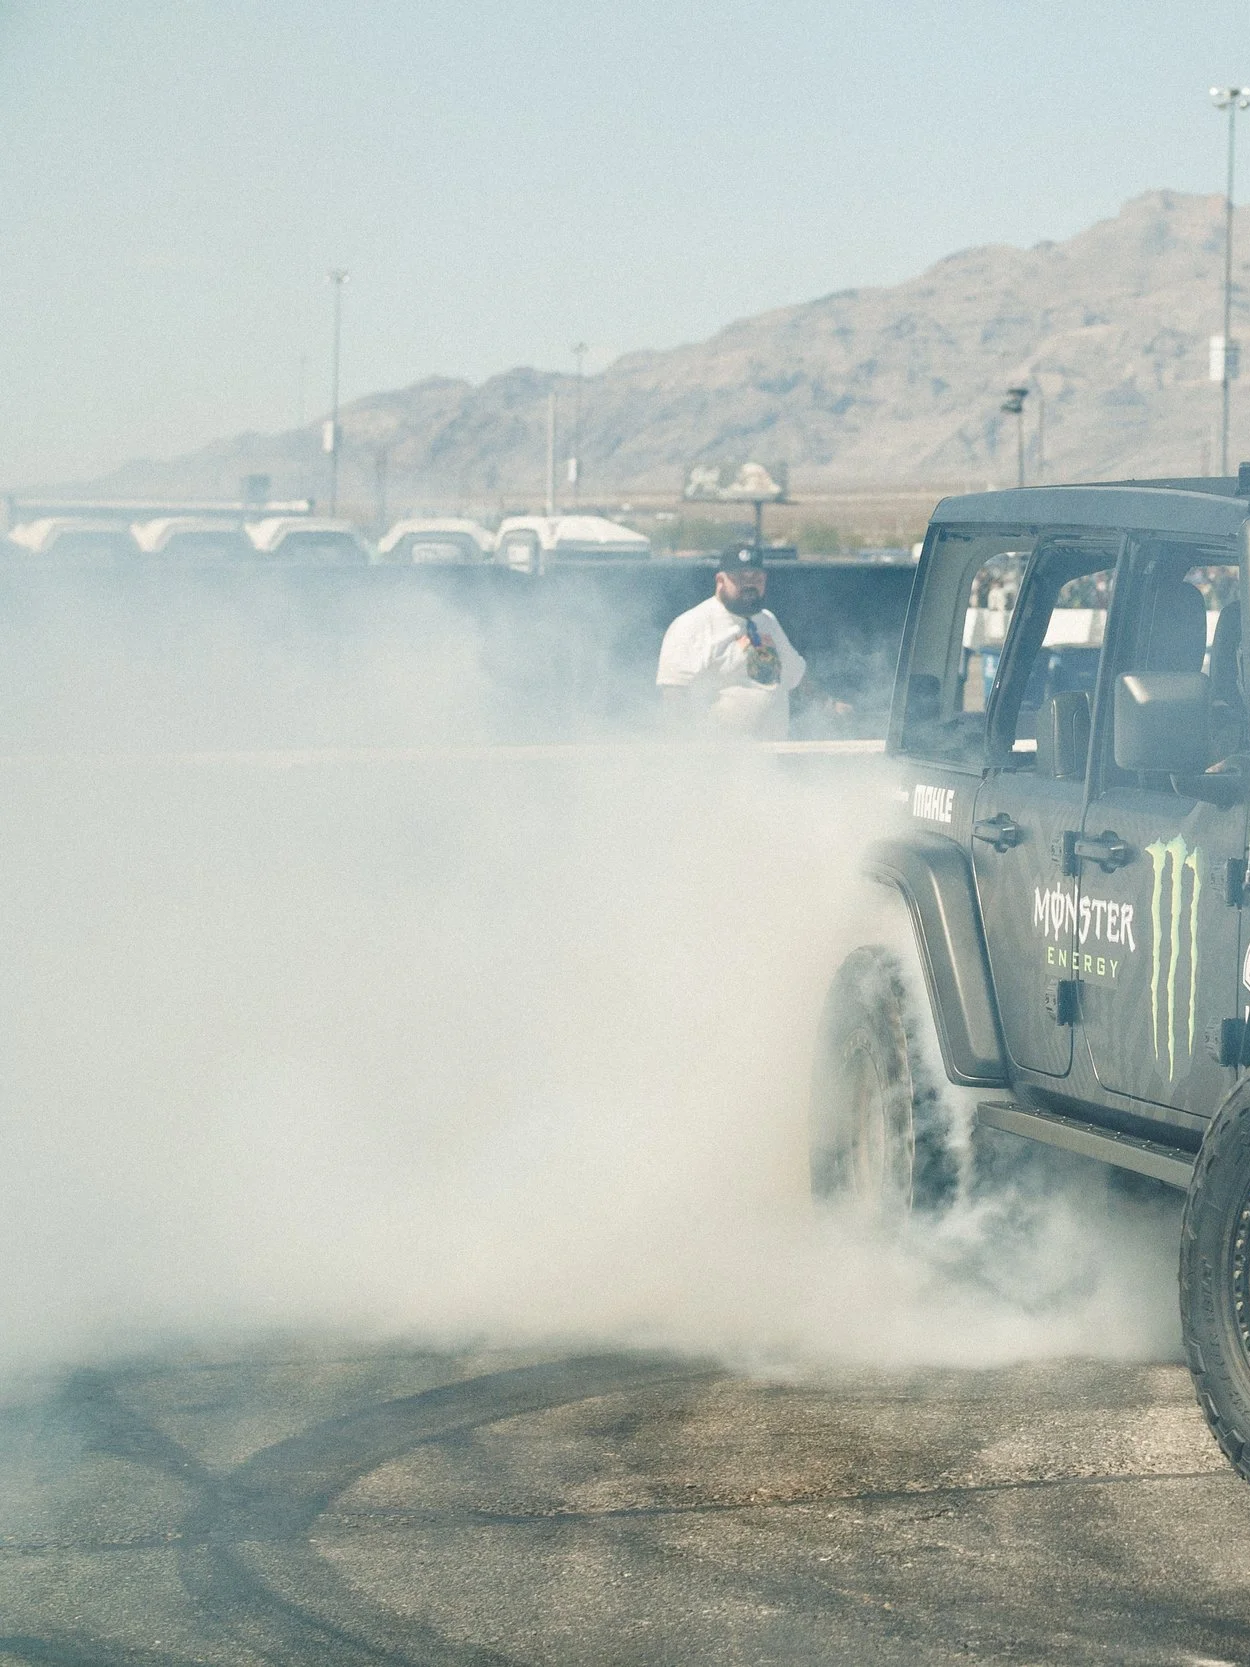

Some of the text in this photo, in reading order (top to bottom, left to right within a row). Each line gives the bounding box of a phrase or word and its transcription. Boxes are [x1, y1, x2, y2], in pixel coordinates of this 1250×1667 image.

[913, 784, 955, 823] MAHLE
[1034, 882, 1136, 953] MONSTER
[1047, 946, 1119, 978] ENERGY
